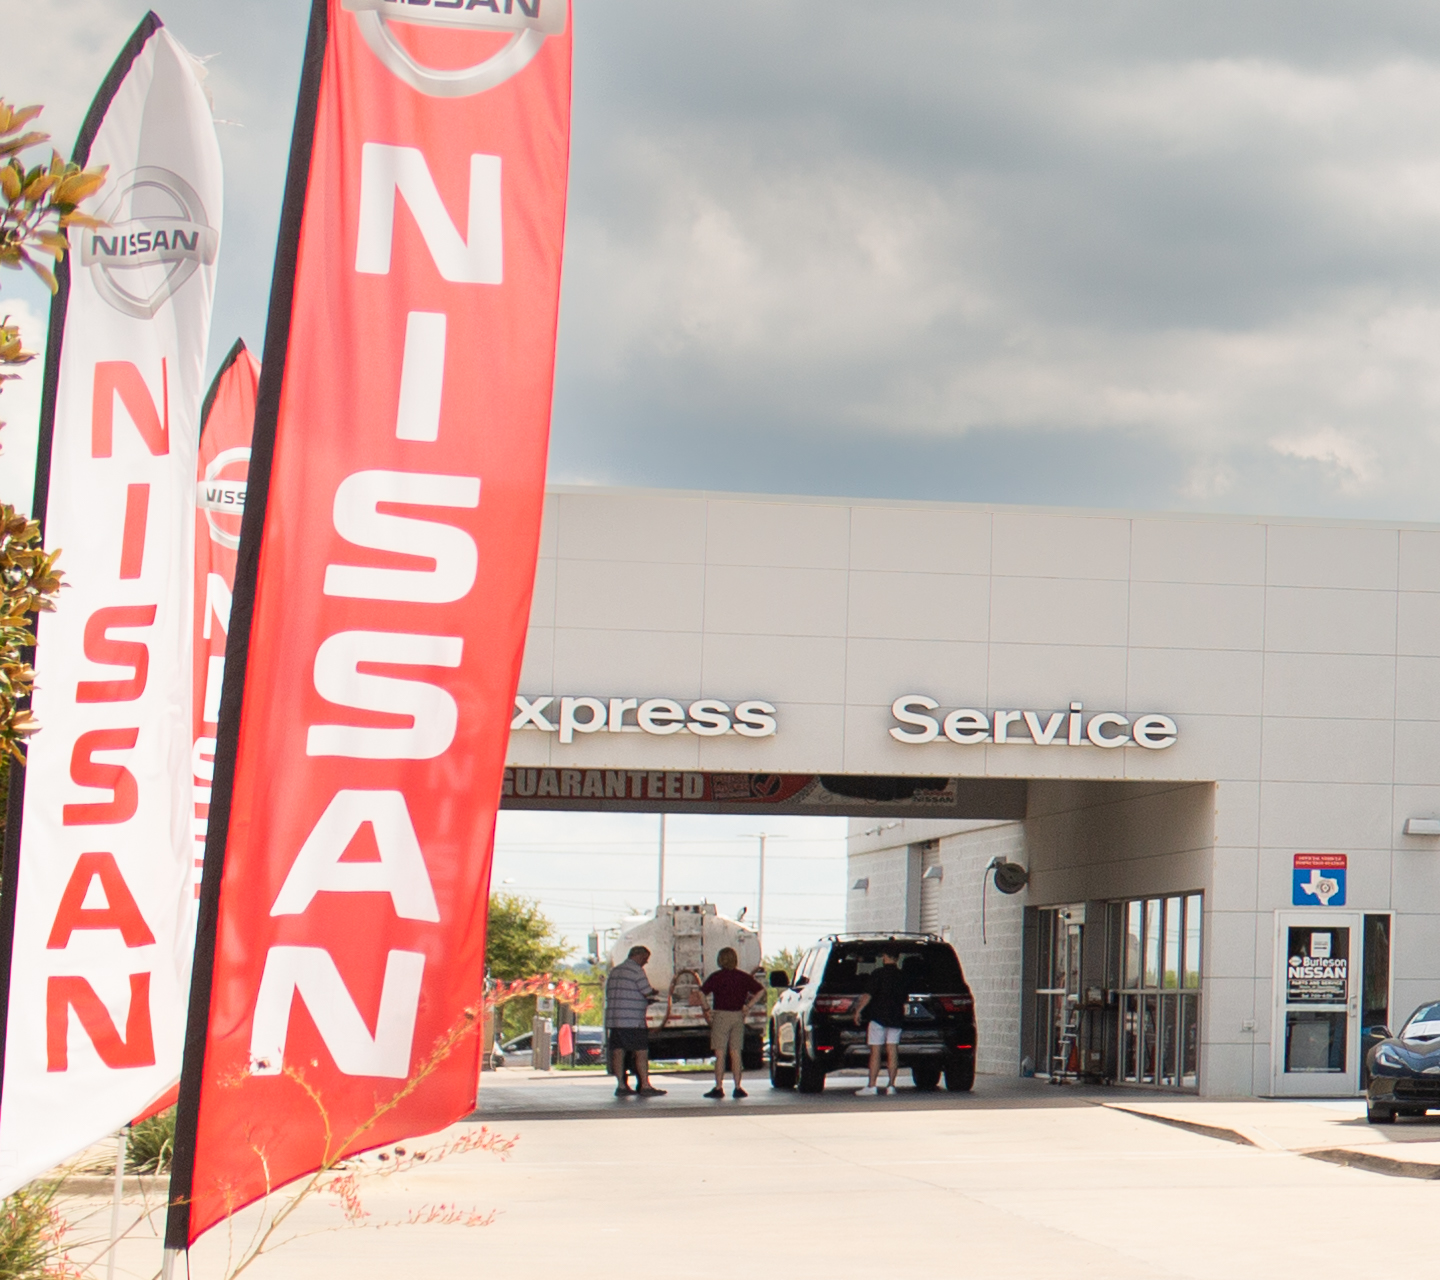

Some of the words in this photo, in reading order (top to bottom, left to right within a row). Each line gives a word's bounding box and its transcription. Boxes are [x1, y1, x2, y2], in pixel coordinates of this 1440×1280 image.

[91, 229, 199, 257] NISSAN
[250, 141, 503, 1079] NISSAN
[46, 357, 170, 1072] NISSAN
[510, 695, 777, 744] xpress
[889, 694, 1178, 750] Service
[1289, 967, 1347, 979] NISSAN
[1303, 956, 1347, 967] Burleson
